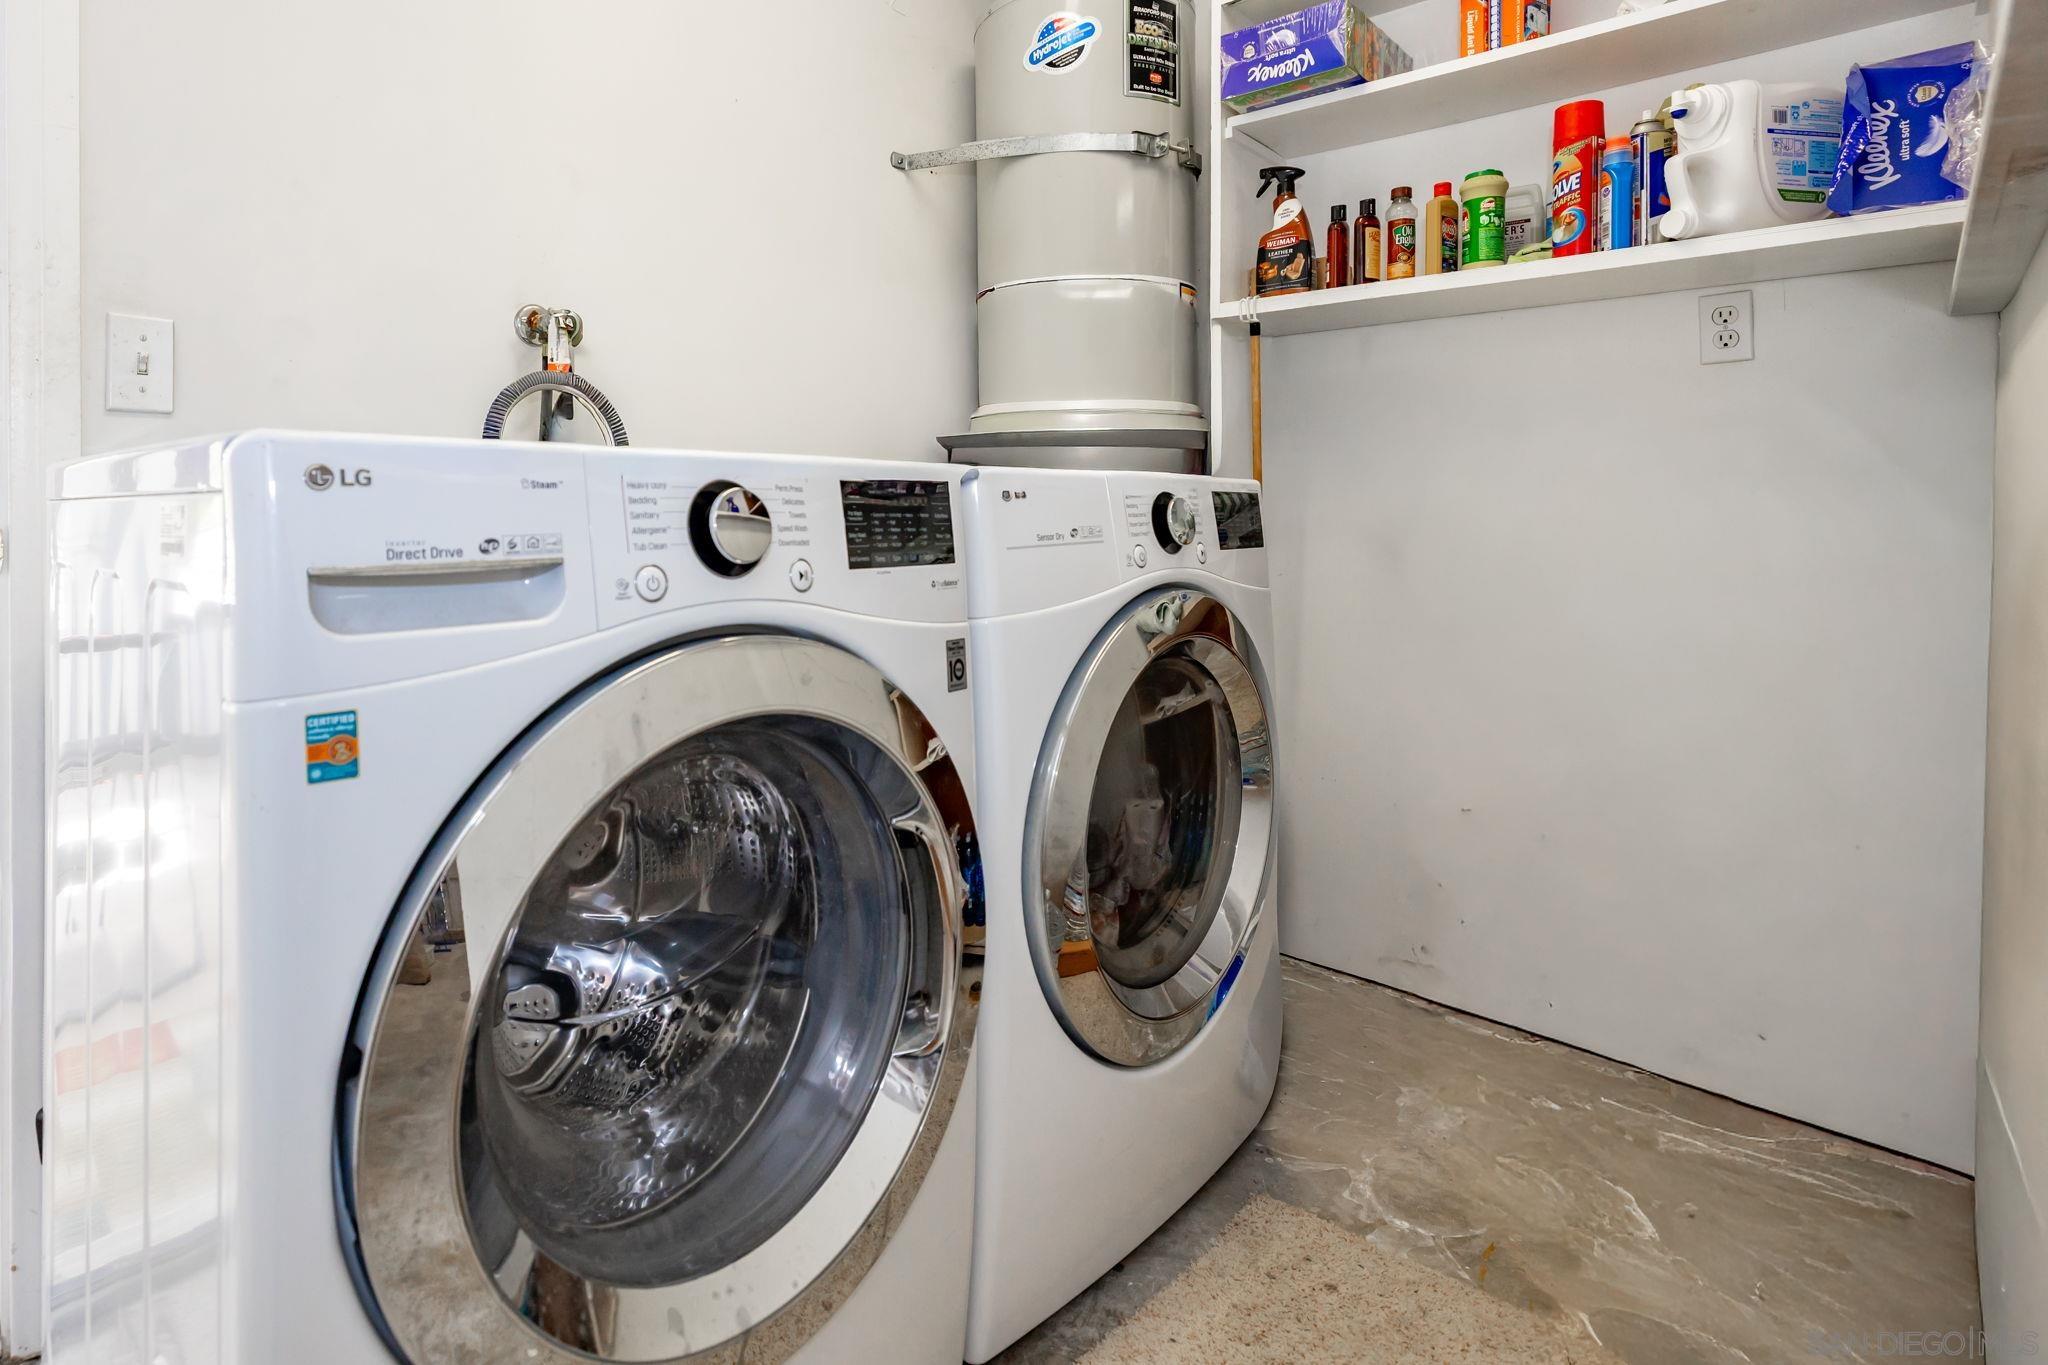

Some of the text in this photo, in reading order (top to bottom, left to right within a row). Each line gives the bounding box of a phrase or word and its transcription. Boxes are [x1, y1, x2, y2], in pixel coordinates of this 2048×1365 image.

[1465, 10, 1475, 34] Liquid
[1032, 31, 1073, 62] Hydrojet
[1467, 35, 1475, 48] Ant
[1264, 46, 1296, 61] ultra soft
[1247, 48, 1316, 83] Kleenex
[1857, 99, 1902, 191] Kleenex
[1898, 119, 1910, 161] ultra soft
[1553, 171, 1582, 201] OLVE
[1401, 225, 1413, 237] Old
[1504, 224, 1526, 236] ER'S
[1266, 236, 1297, 249] WEIMAN
[1267, 248, 1294, 258] LEATHER
[340, 469, 373, 488] LG
[628, 496, 657, 506] Bedding
[630, 511, 660, 520] Sanitary
[1036, 533, 1065, 543] Sensor Dry
[385, 545, 464, 561] Direct Drive
[634, 542, 668, 551] Tub Clean
[306, 714, 355, 728] CERTIFIED
